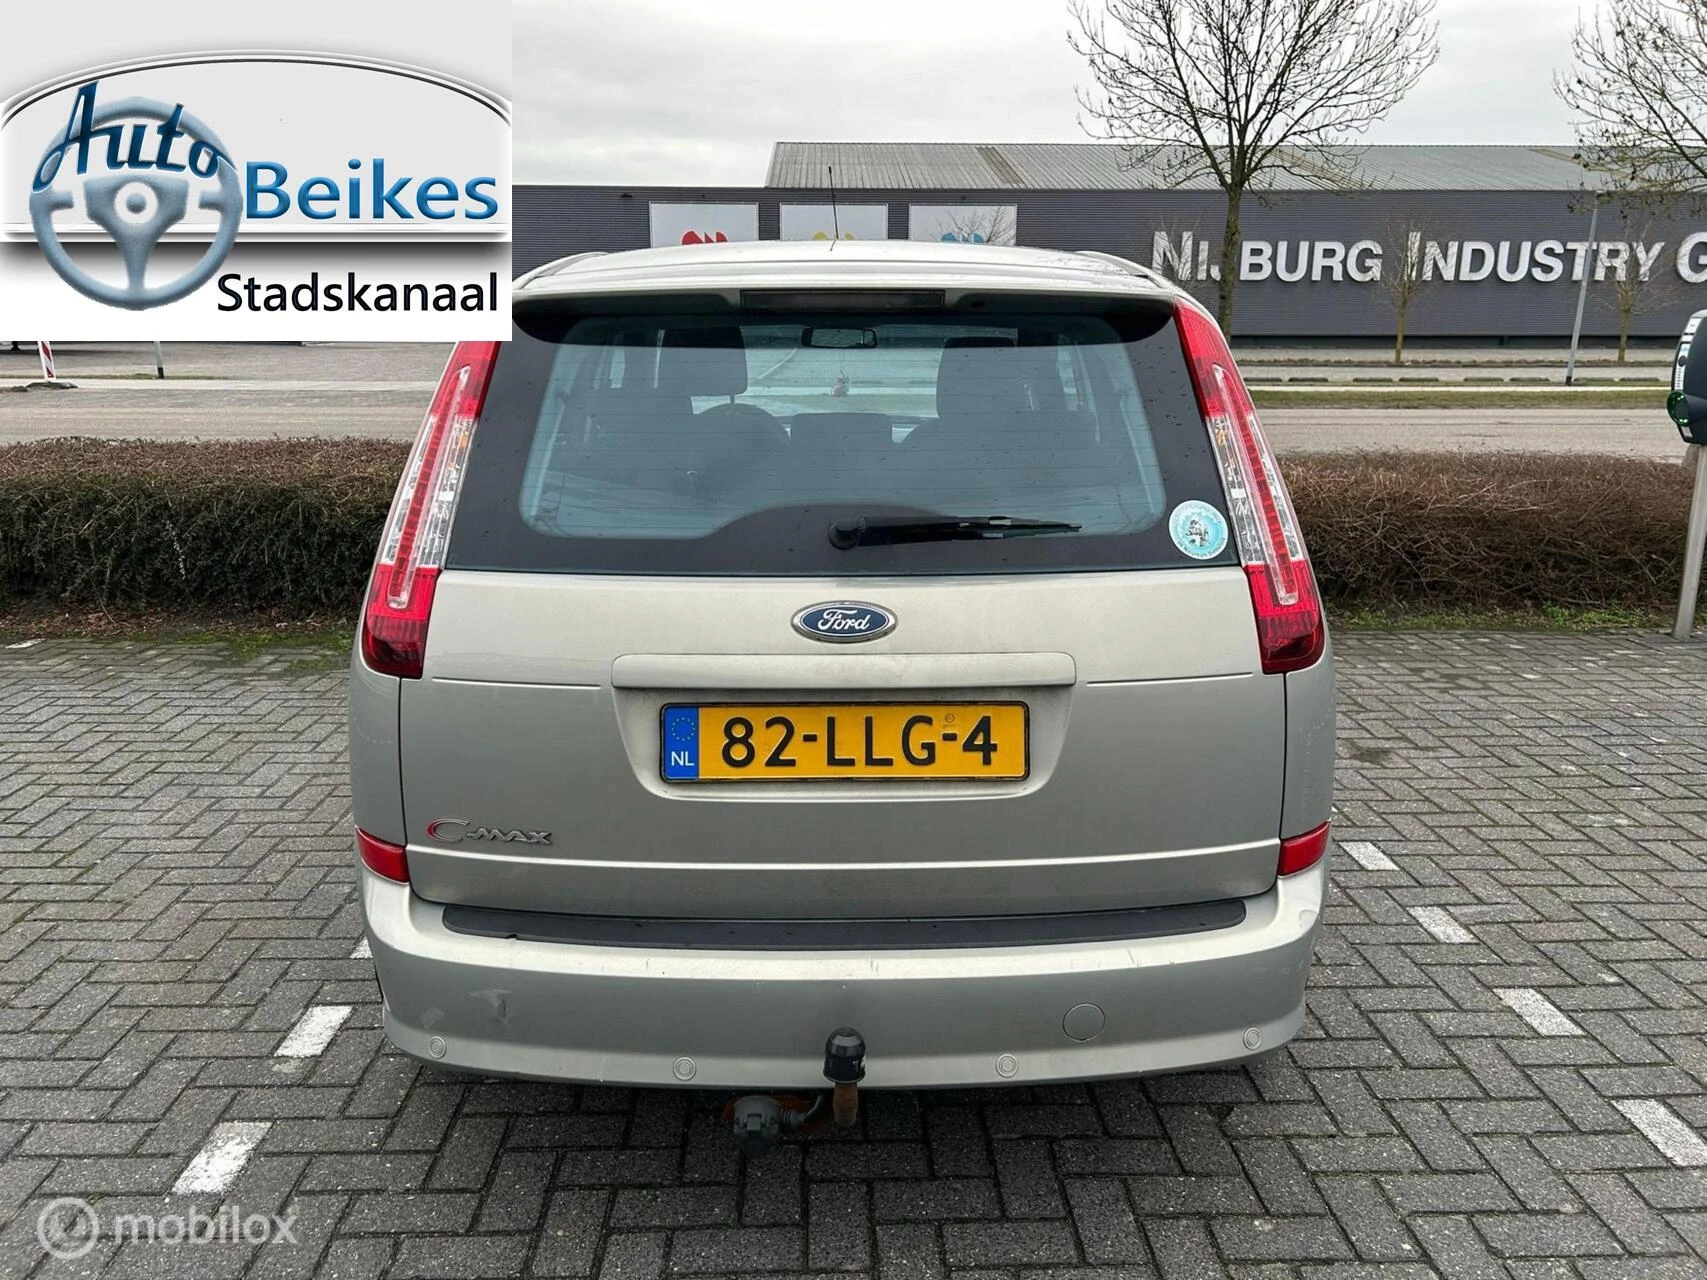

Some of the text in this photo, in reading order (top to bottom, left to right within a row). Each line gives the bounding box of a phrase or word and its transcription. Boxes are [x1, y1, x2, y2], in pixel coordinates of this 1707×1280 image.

[817, 608, 871, 631] Ford
[670, 715, 998, 768] NL 82-LLG-4
